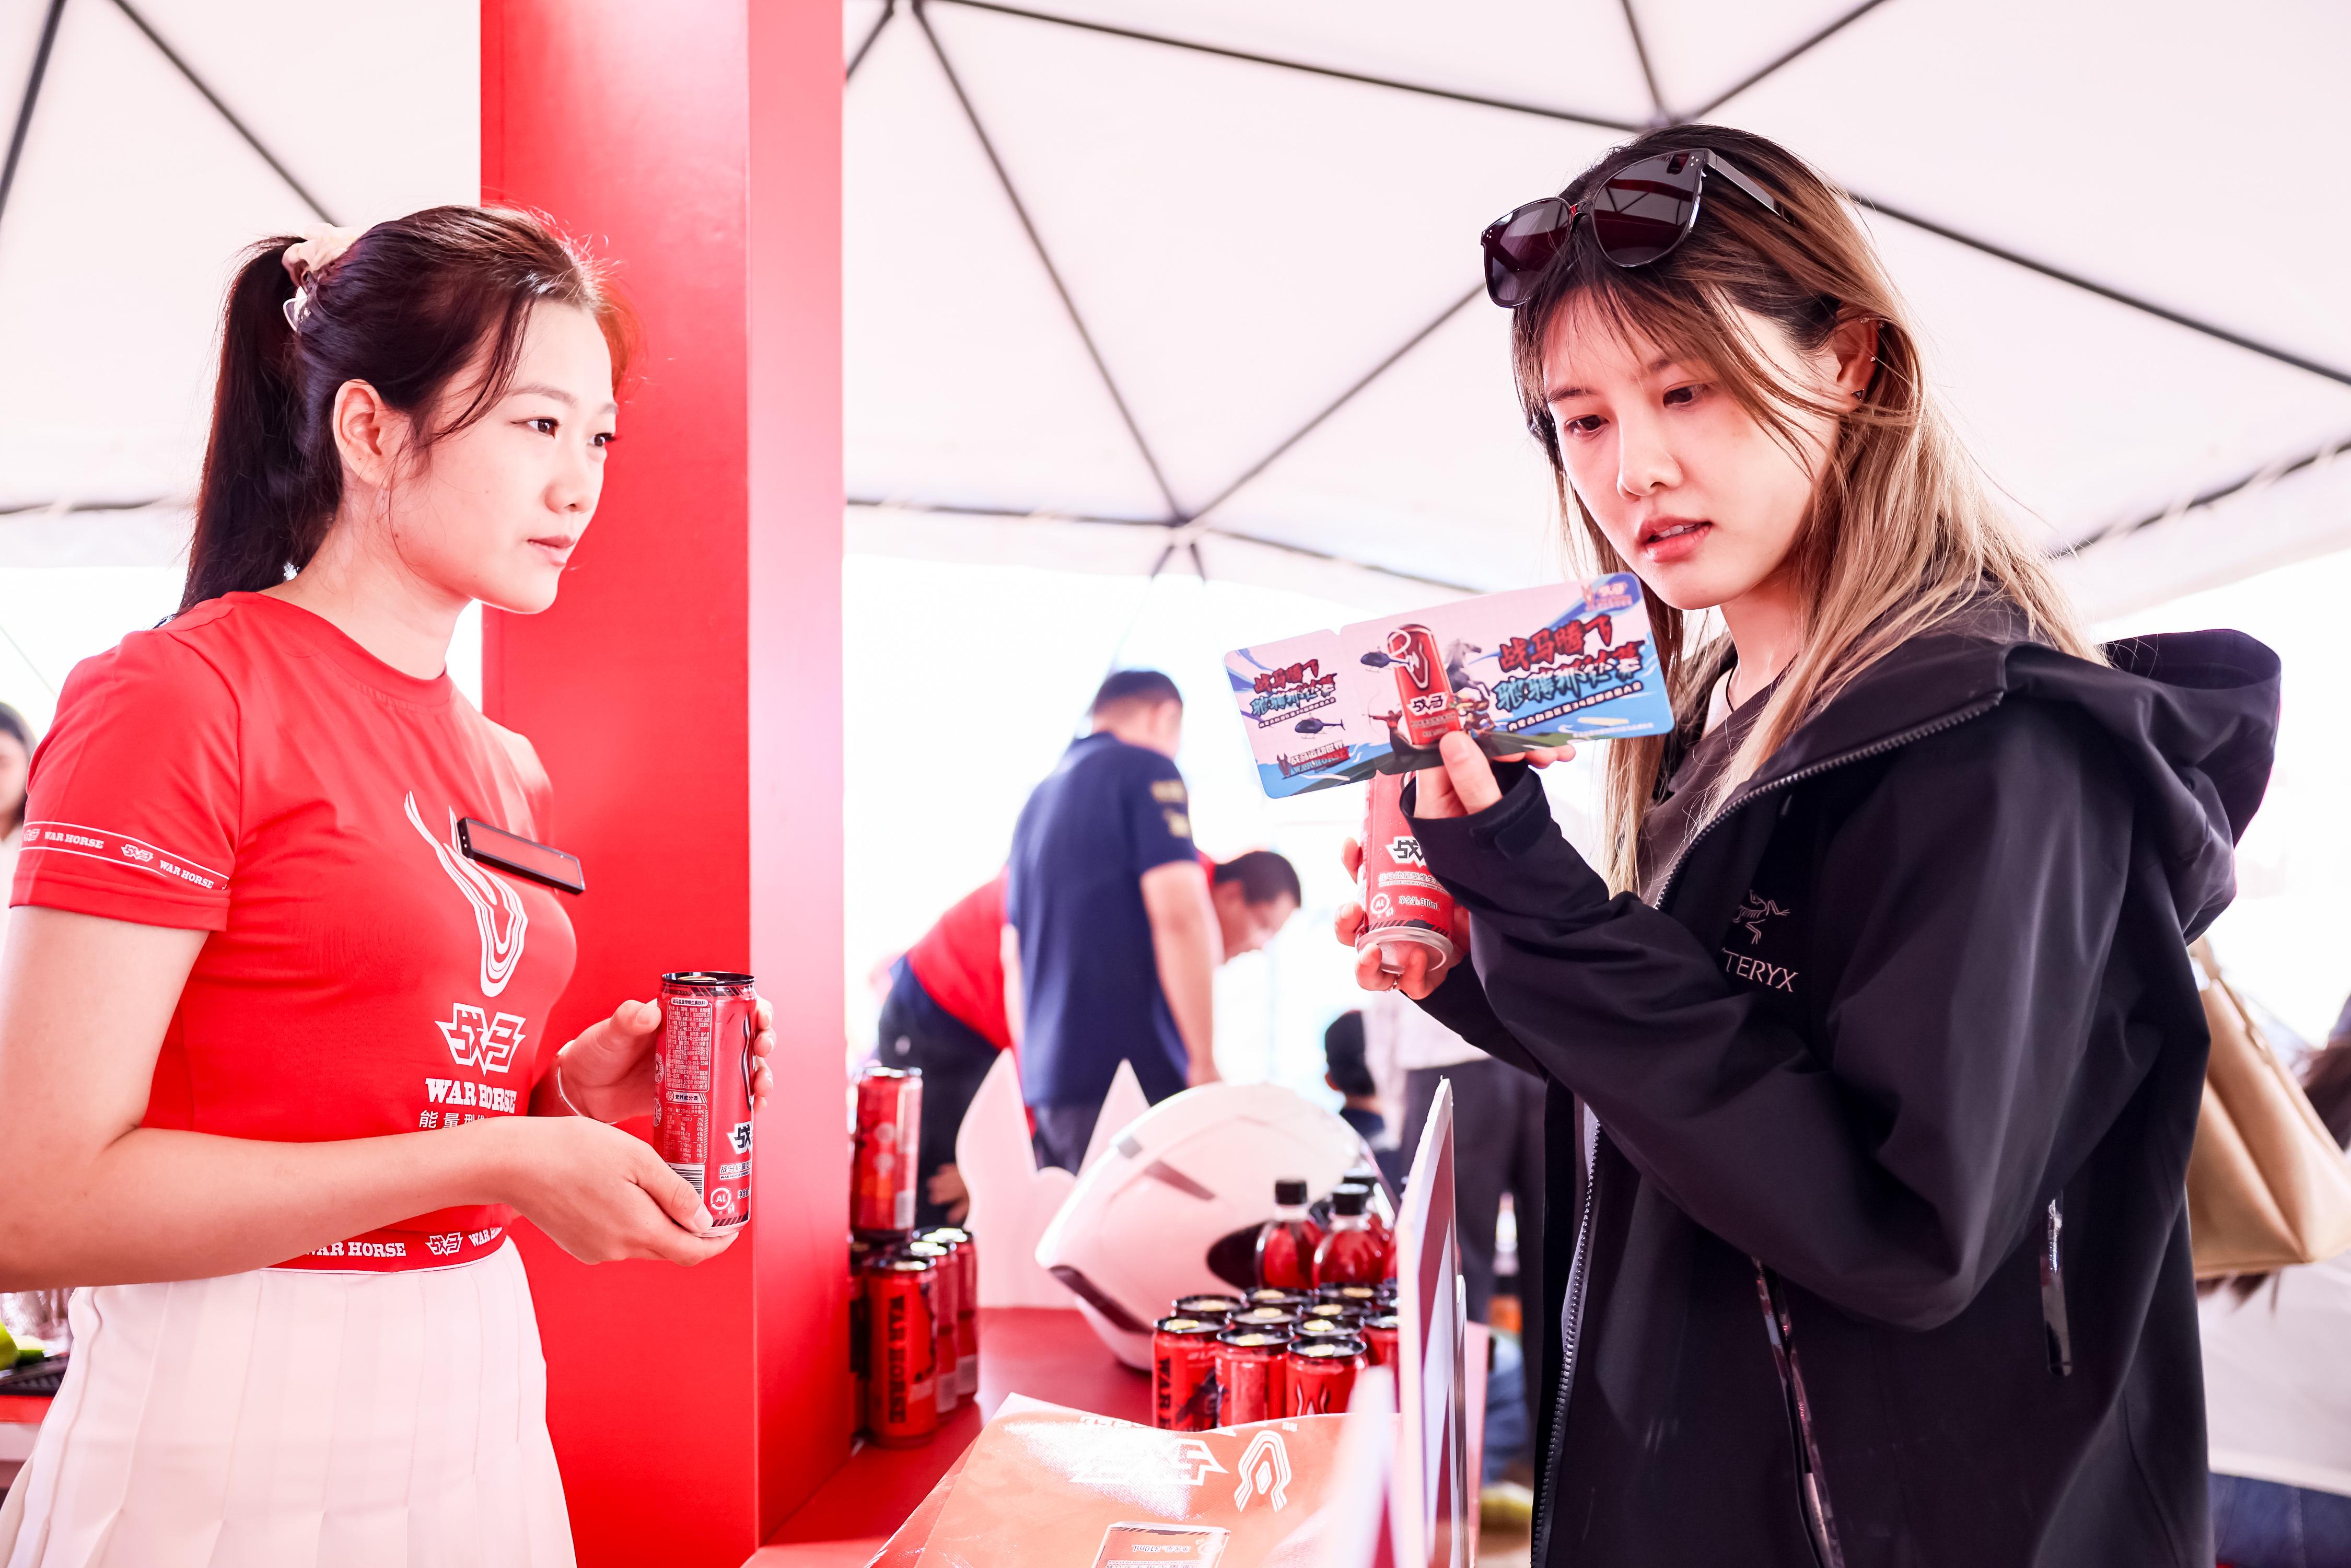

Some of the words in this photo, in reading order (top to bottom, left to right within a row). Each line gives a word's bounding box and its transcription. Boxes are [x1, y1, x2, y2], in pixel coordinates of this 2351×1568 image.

[44, 831, 64, 841] WAR
[65, 834, 104, 849] HORSE
[160, 860, 181, 876] WAR
[182, 869, 214, 889] HORSE
[1722, 947, 1799, 992] TERYX
[425, 1078, 477, 1106] WAR
[478, 1084, 517, 1113] HORSE
[306, 1241, 345, 1256] AR
[348, 1242, 406, 1257] HORSE
[468, 1229, 491, 1247] WAR
